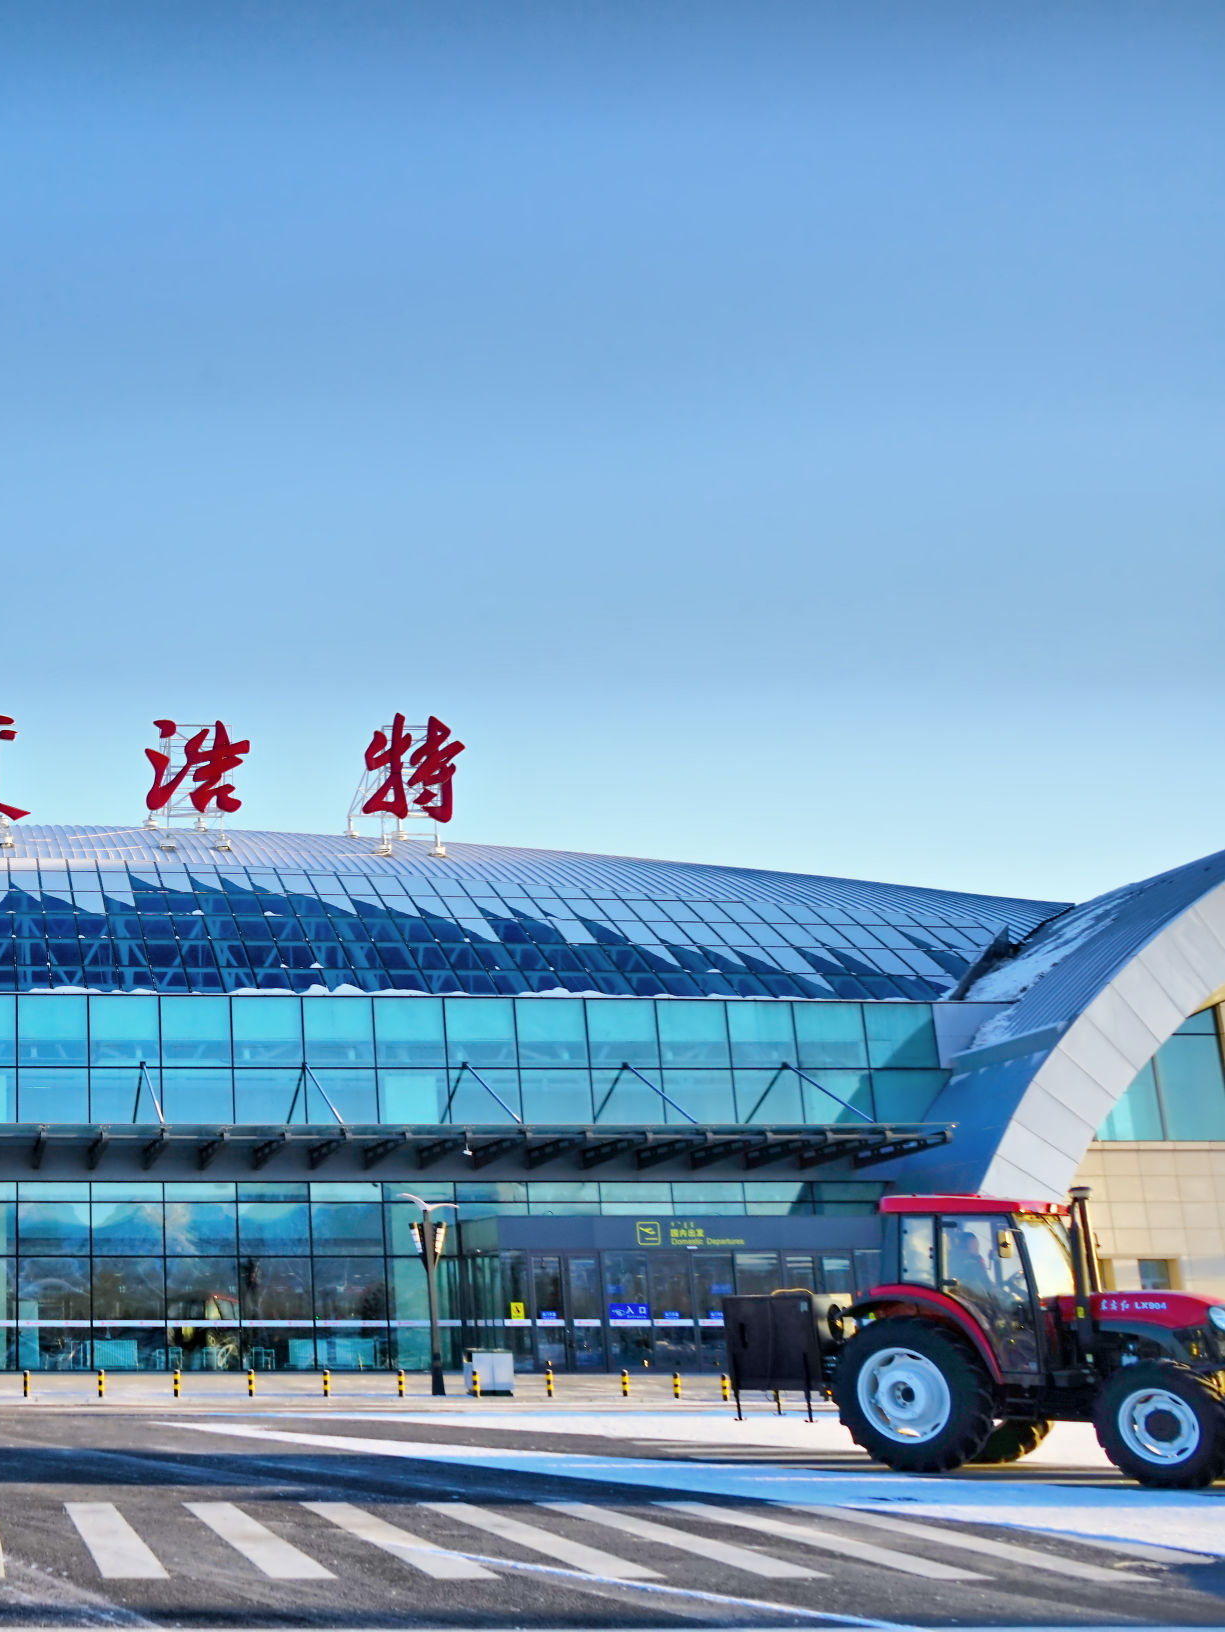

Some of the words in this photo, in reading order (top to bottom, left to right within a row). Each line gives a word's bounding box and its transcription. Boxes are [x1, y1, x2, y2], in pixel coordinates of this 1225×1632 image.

[670, 1228, 705, 1237] 国内出发
[706, 1237, 745, 1246] Departures
[625, 1305, 647, 1315] 入口
